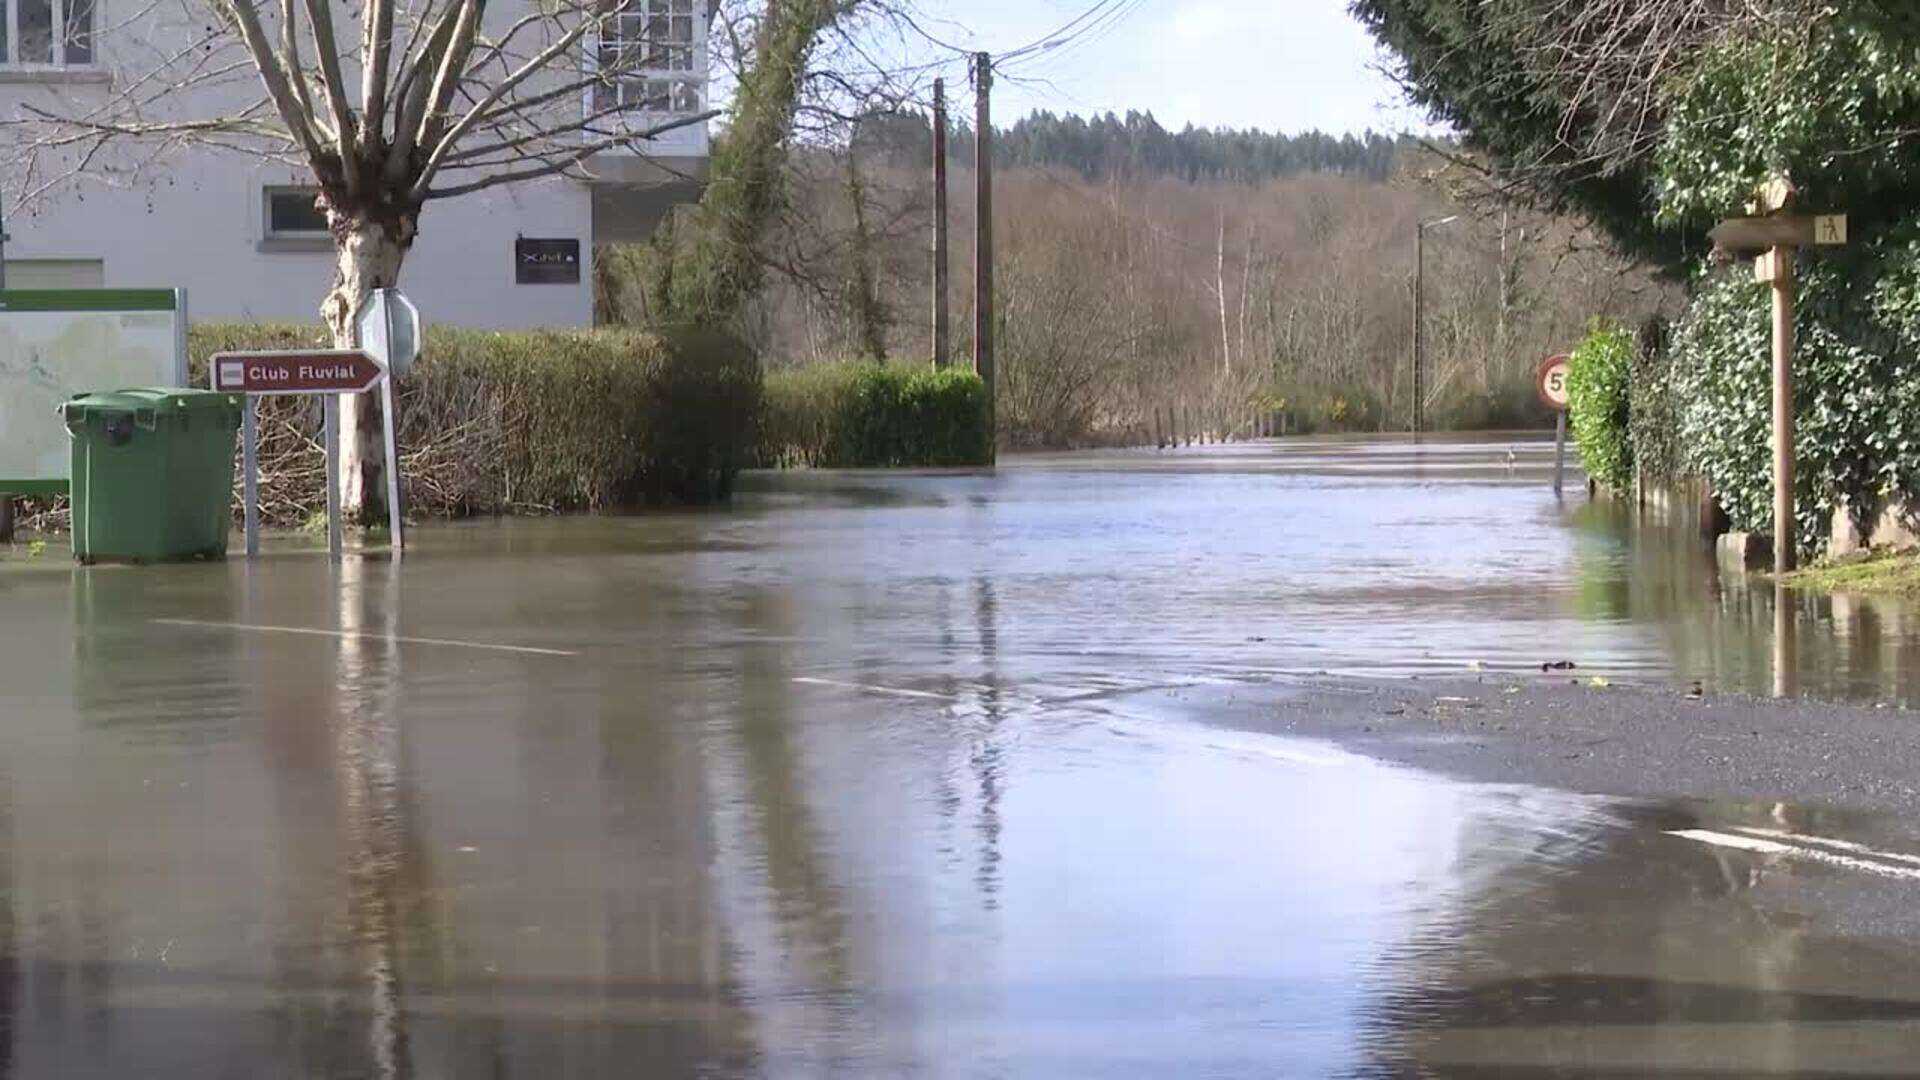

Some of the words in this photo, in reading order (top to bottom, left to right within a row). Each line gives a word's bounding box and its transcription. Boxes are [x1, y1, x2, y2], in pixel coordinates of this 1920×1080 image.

[249, 366, 289, 380] Club
[299, 365, 356, 379] Fluvial
[1550, 372, 1563, 392] 5
